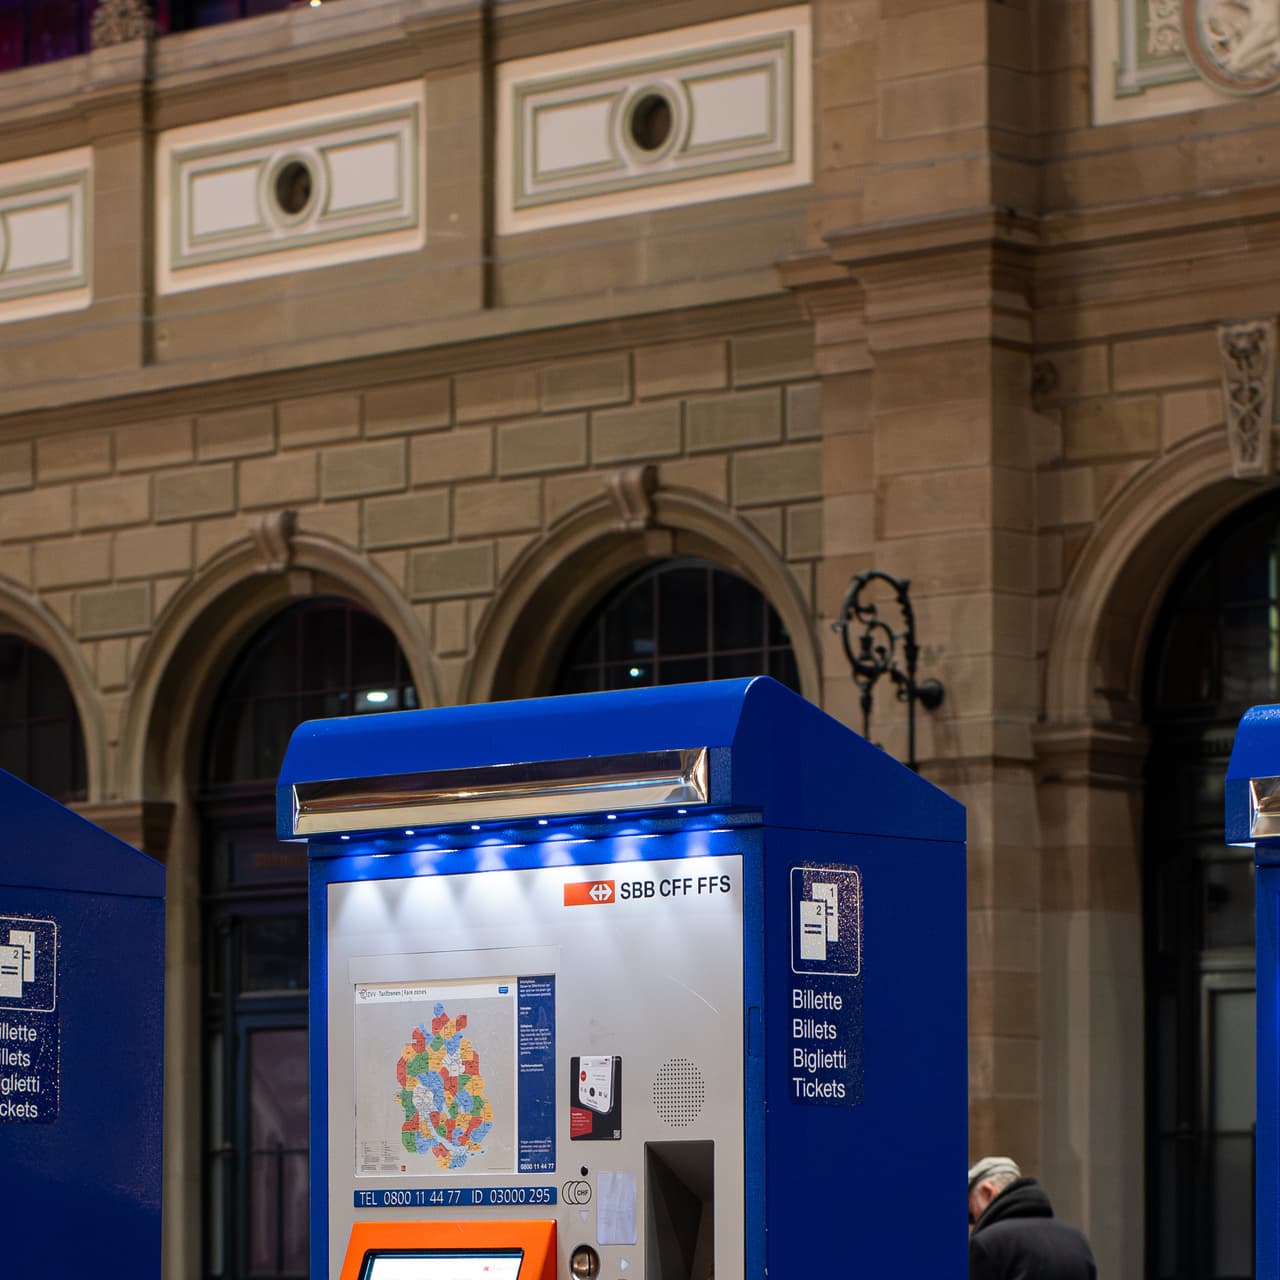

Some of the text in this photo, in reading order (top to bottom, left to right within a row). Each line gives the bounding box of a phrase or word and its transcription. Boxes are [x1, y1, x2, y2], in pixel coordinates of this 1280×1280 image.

[621, 875, 730, 899] SBB CFF FFS
[793, 989, 842, 1010] Billette
[793, 1019, 837, 1039] Billets
[793, 1048, 846, 1073] Biglietti
[793, 1077, 845, 1098] Tickets
[360, 1189, 550, 1205] TEL 0800 11 44 77 ID 03000 295
